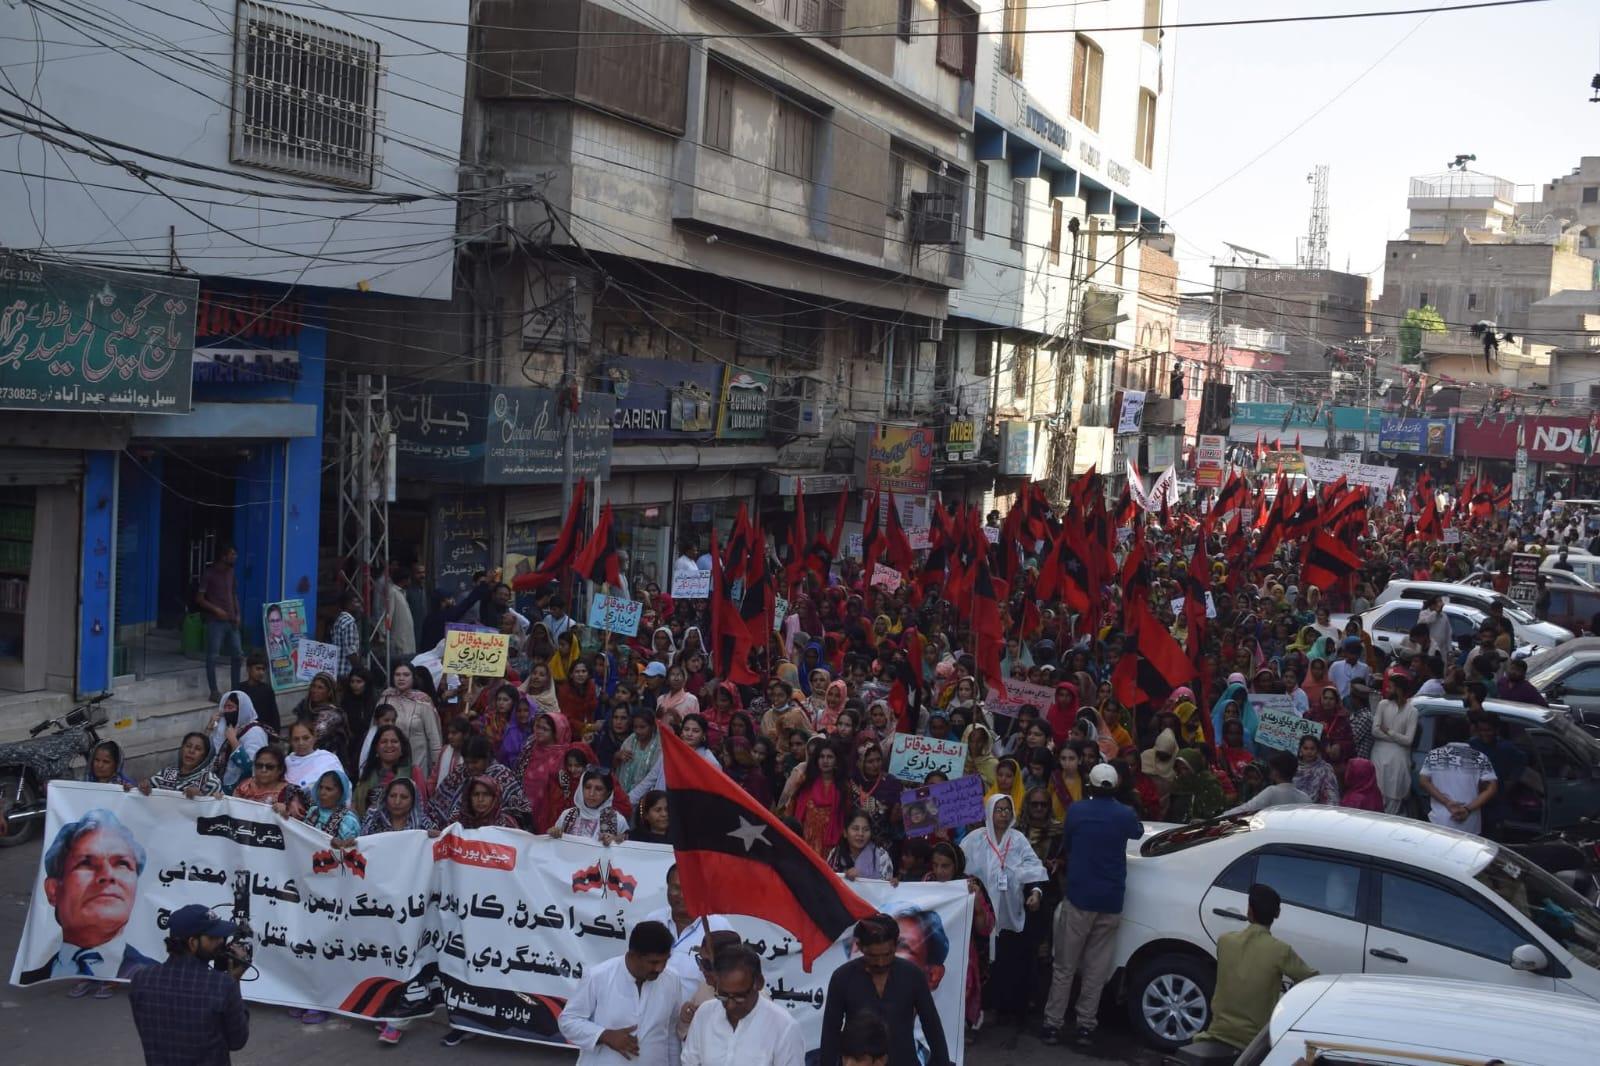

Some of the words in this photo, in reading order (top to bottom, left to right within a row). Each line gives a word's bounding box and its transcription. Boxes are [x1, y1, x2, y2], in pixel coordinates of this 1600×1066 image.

[613, 407, 668, 430] CARIENT
[949, 421, 974, 442] HYDER
[1532, 425, 1600, 456] NDU
